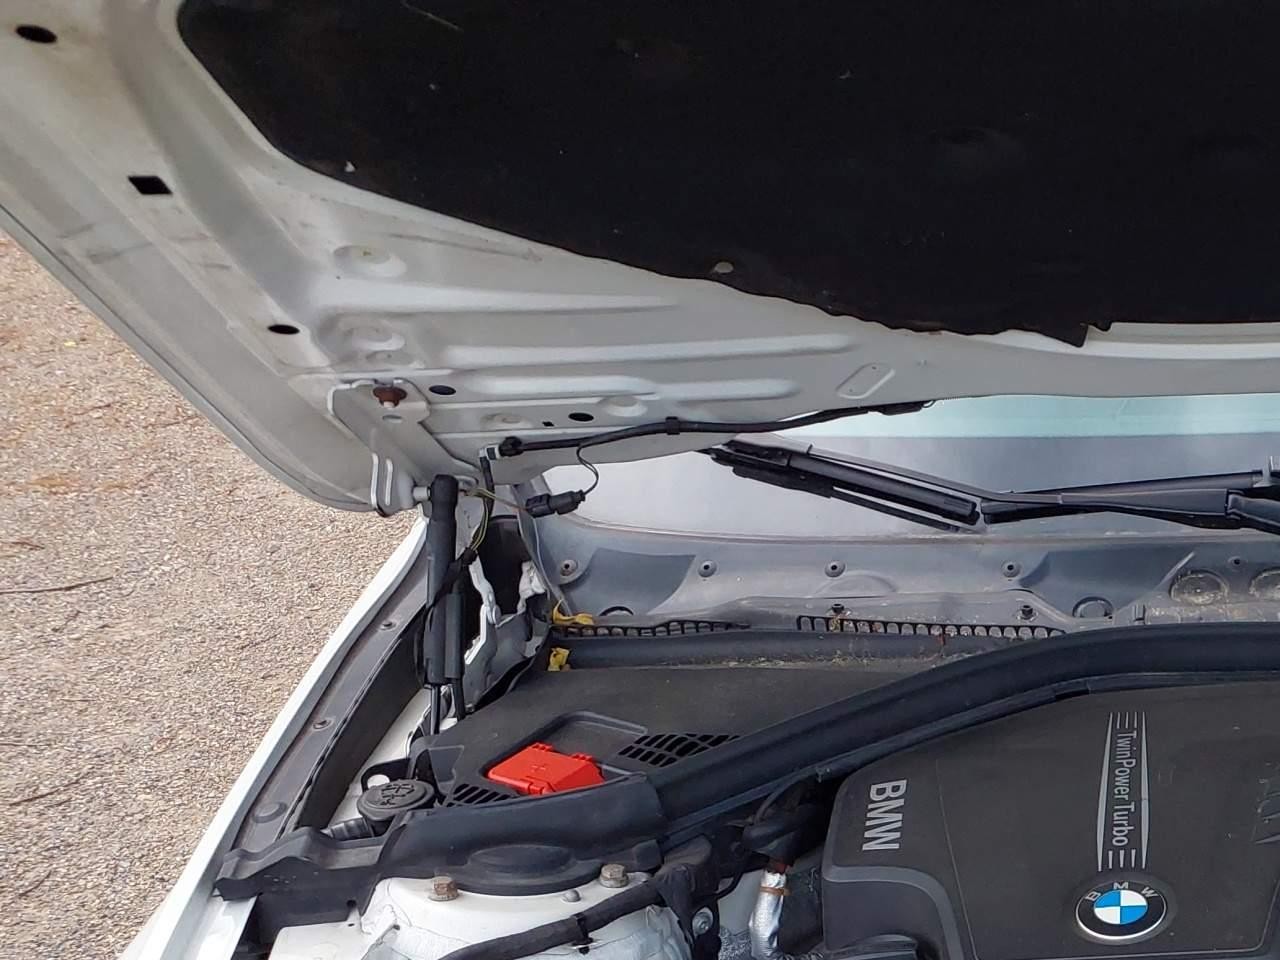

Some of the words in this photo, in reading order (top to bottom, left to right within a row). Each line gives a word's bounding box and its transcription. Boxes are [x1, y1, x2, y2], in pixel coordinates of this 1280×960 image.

[1113, 730, 1137, 801] TwinPower
[862, 779, 907, 850] BMW
[1111, 801, 1135, 846] Turbo
[1085, 881, 1159, 901] BMW
